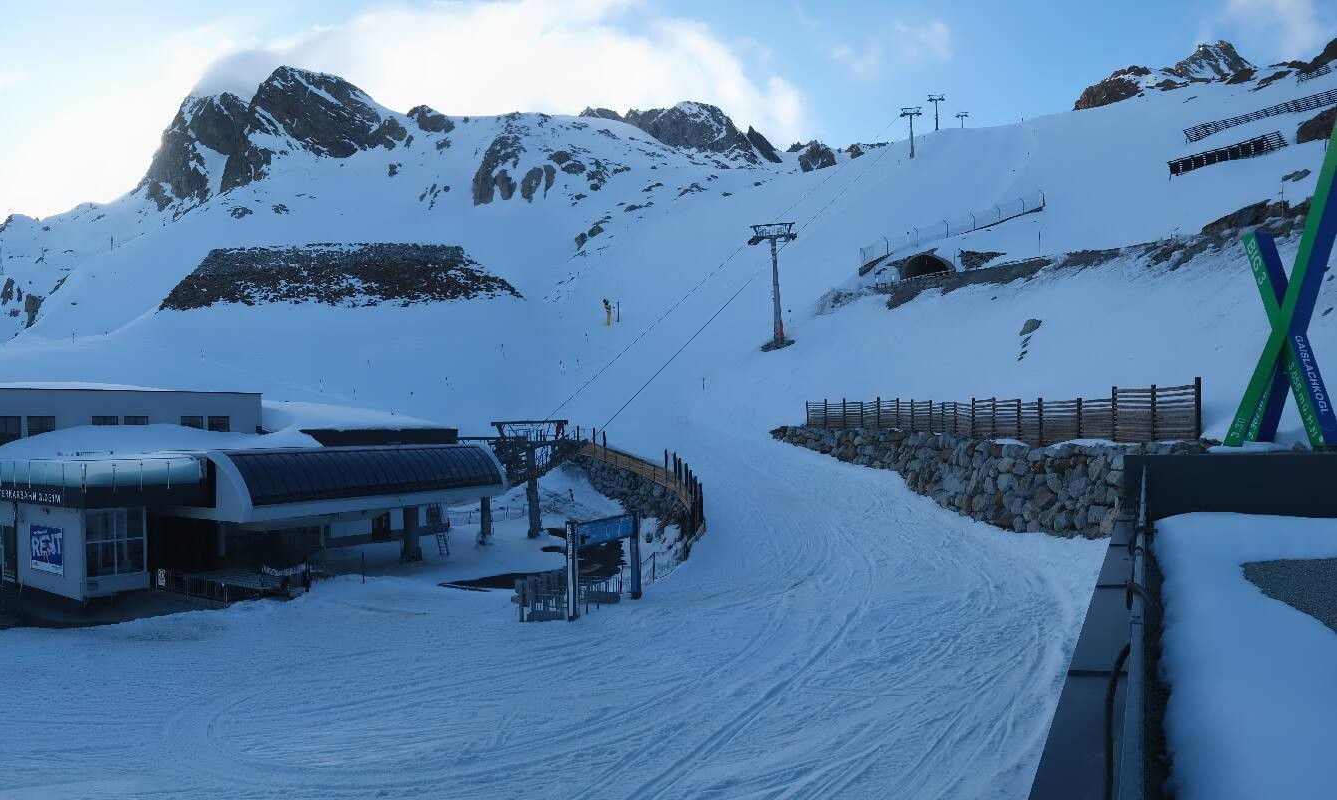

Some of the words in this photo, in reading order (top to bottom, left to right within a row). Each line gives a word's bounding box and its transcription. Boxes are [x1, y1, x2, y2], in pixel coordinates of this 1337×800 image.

[1247, 238, 1262, 271] BIG
[1258, 271, 1267, 286] 3
[1295, 335, 1329, 415] GAISLACHKOGL
